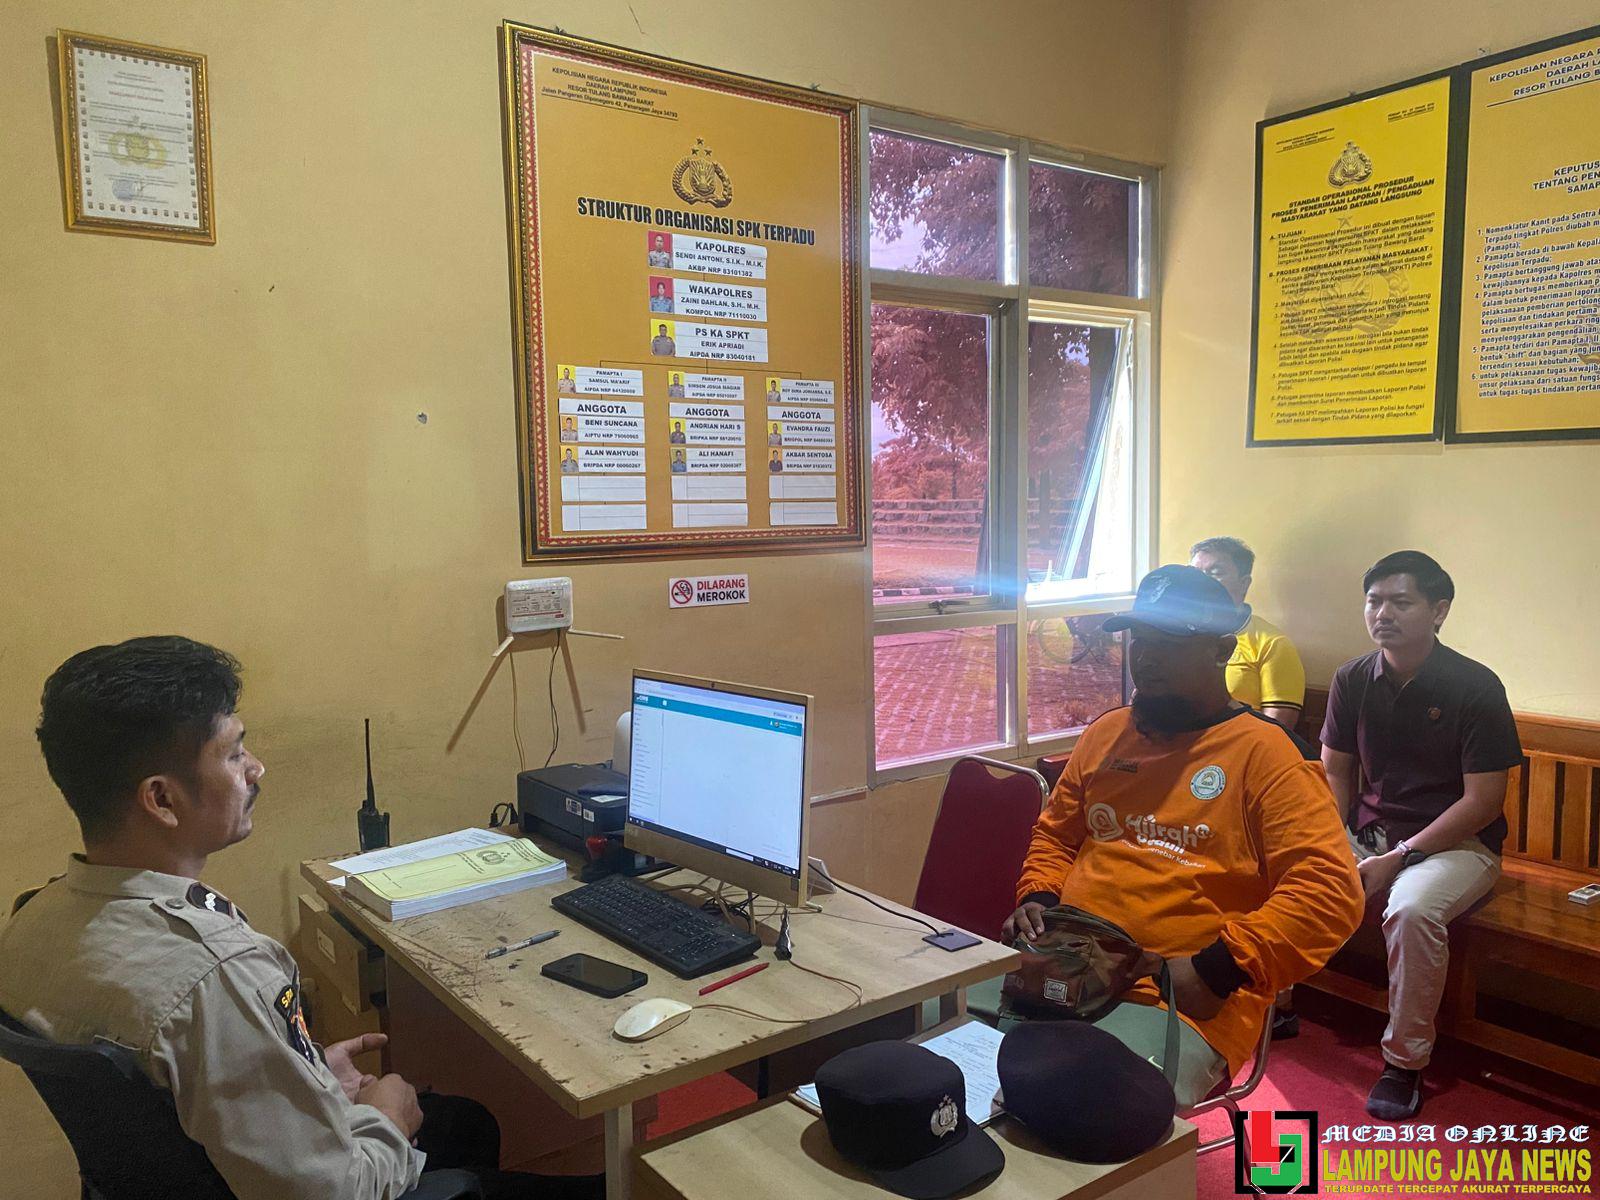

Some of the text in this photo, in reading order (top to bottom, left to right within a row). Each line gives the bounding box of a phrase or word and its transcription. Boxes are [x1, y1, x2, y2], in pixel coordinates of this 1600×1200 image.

[1490, 50, 1594, 82] KEPOLISIAN NEGARA
[1546, 62, 1589, 78] DAERAH
[553, 68, 667, 96] KEPOLISIAN NEGARA REPUBLIK INDONESIA
[586, 82, 636, 96] DAERAH LAMPUNG
[1514, 71, 1591, 96] RESOR TULANG
[568, 84, 653, 106] RESOR TULANG BAWANG BARAT
[1533, 176, 1578, 190] TENTANG
[1272, 179, 1435, 217] PROSES PENERIMAAN LAPORAN PENGADUAN
[1288, 176, 1414, 208] STANDAR OPERASIONAL PROSEDUR
[1281, 190, 1422, 223] MASYARAKAT YANG DATANG LANGSUNG
[578, 197, 815, 247] STRUKTUR ORGANISASI SPK TERPADU
[1531, 219, 1550, 227] Kanit
[1552, 215, 1569, 224] pada
[1572, 211, 1596, 220] Sentra
[1278, 230, 1302, 239] TUJUAN
[1514, 220, 1591, 239] tingkat Polres diubah
[696, 242, 746, 255] KAPOLRES
[1484, 252, 1513, 261] Pamapta
[1515, 248, 1540, 257] berada
[1551, 243, 1575, 252] bawah
[675, 252, 695, 260] SENDI
[1277, 246, 1429, 276] PROSES PENERIMAAN PELAYANAN MASYARAKAT
[1484, 260, 1519, 271] Kepolisian
[1484, 260, 1584, 280] Pamapta bertanggung jawab
[1483, 269, 1592, 289] kewajibannya kepada Kapolres
[689, 285, 752, 299] WAKAPOLRES
[1483, 278, 1592, 299] Pamapta bertugas memberikan
[1504, 296, 1527, 304] bentuk
[1530, 290, 1572, 302] penerimaan
[1482, 302, 1564, 316] pelaksanaan pemberian
[1482, 315, 1516, 325] kepolisian
[1533, 311, 1564, 319] tindakan
[1566, 308, 1598, 317] pertama
[1500, 322, 1552, 333] menyelesaikan
[1554, 318, 1583, 328] perkara
[1547, 326, 1597, 338] pengendalian
[695, 328, 750, 340] PS KA SPKT
[1551, 337, 1585, 346] Pamapta
[1480, 354, 1502, 362] bentuk
[1543, 348, 1568, 357] bagian
[1570, 346, 1587, 355] yang
[1480, 362, 1512, 370] tersendiri
[1514, 360, 1536, 368] sesuai
[1500, 368, 1545, 379] pelaksanaan
[1547, 367, 1567, 376] tugas
[1479, 381, 1497, 389] unsur
[1499, 378, 1535, 388] pelaksana
[1552, 376, 1577, 384] satuan
[577, 404, 627, 415] ANGGOTA
[685, 408, 729, 418] ANGGOTA
[782, 411, 821, 420] ANGGOTA
[697, 578, 745, 591] DILARANG
[697, 590, 745, 602] MEROKOK
